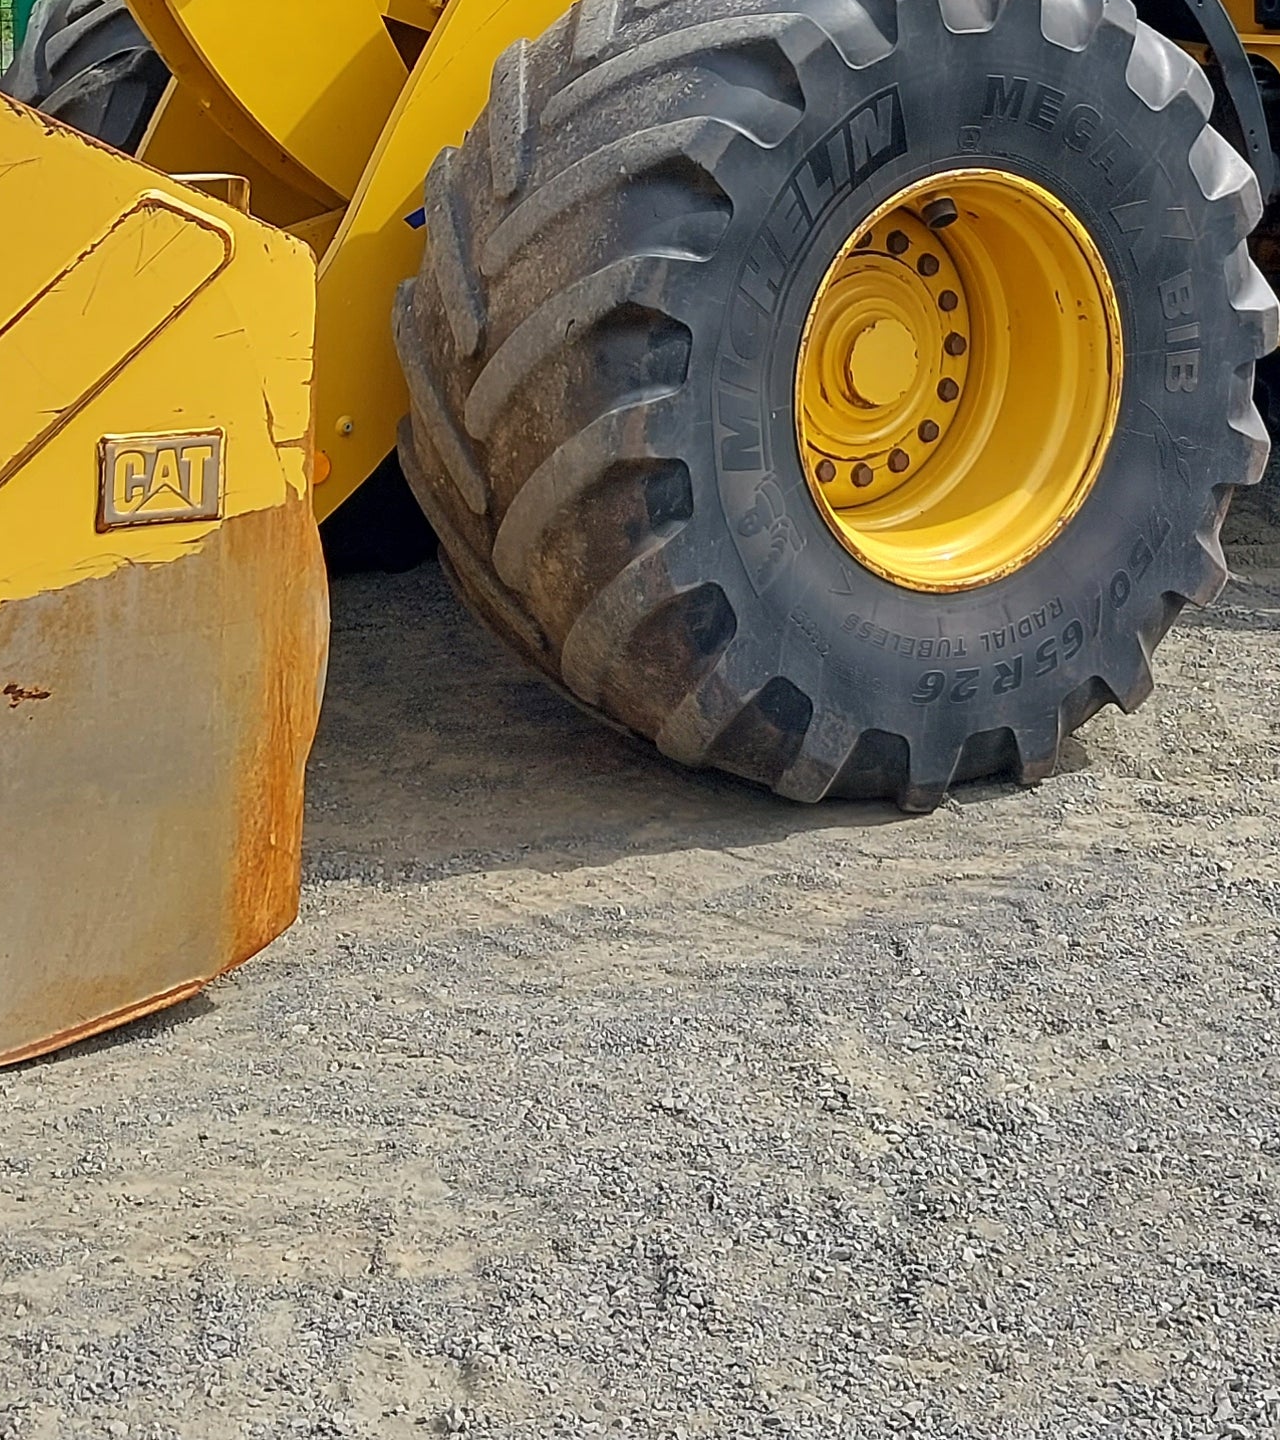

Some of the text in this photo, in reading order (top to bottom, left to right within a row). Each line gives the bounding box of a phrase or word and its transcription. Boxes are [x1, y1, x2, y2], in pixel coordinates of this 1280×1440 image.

[981, 73, 1135, 187] MEGA
[1157, 268, 1201, 393] BIB
[717, 91, 896, 473] MICHELIN
[112, 445, 213, 514] CAT
[840, 611, 968, 659] TUBELESS
[979, 595, 1065, 652] RADIAL
